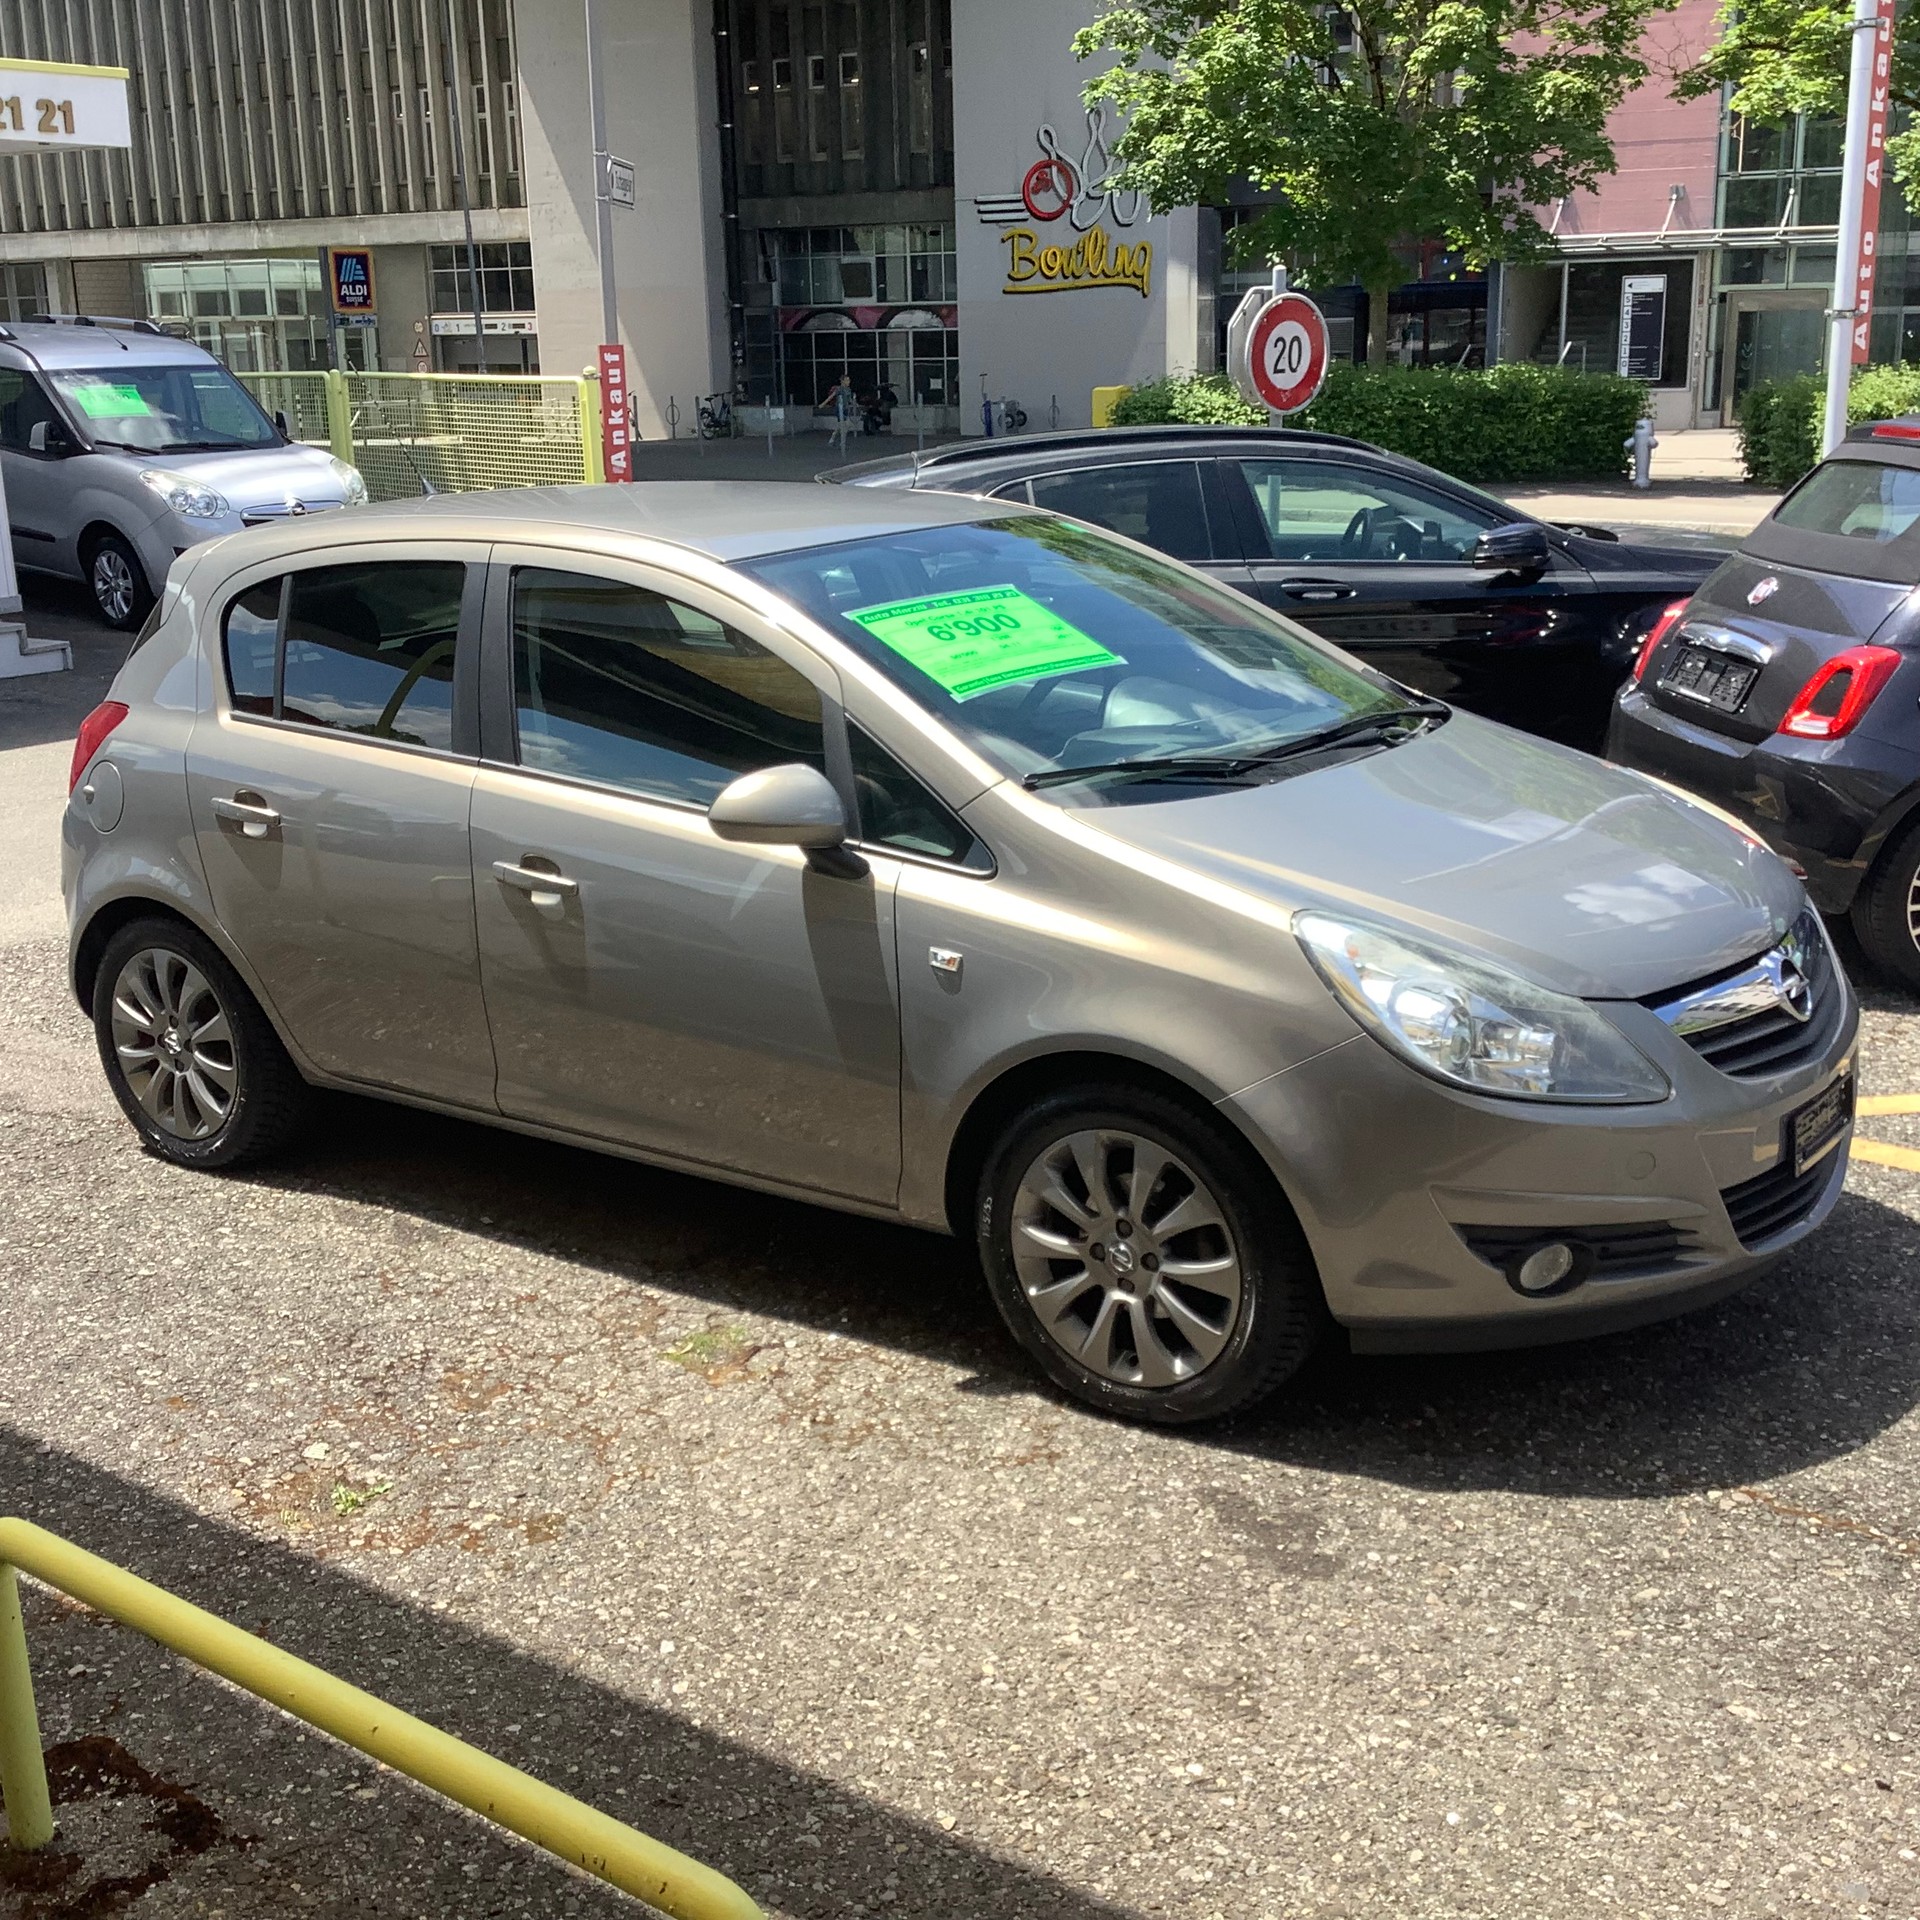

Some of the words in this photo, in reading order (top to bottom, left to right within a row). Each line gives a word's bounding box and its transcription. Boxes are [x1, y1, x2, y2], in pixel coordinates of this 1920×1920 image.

[36, 98, 75, 134] 21
[1001, 224, 1153, 298] Bowling
[341, 284, 368, 296] ALDI
[1855, 231, 1874, 350] Auto
[501, 322, 507, 331] 2
[527, 322, 533, 331] 3
[1273, 335, 1303, 374] 20
[604, 352, 627, 470] Ankauf
[863, 612, 890, 622] Auto
[927, 613, 1021, 641] 6'900
